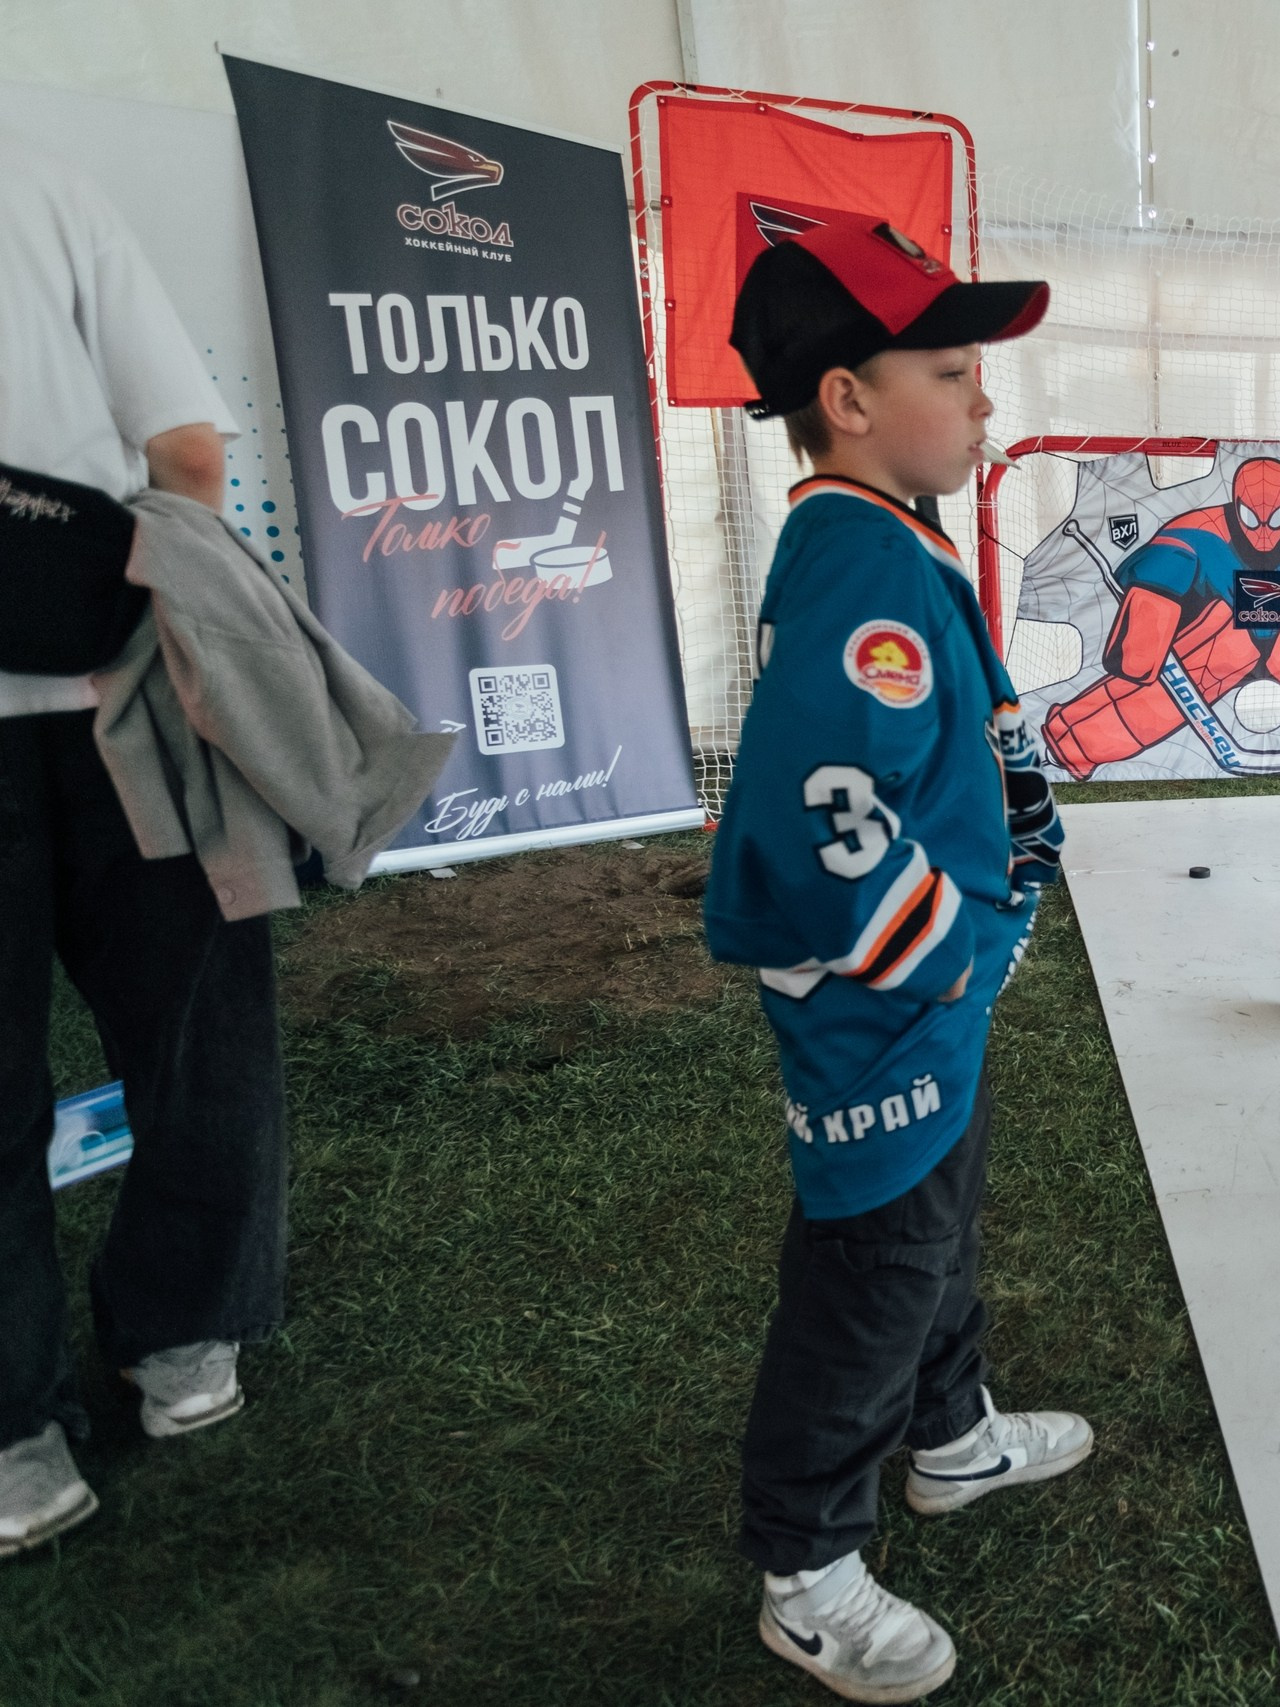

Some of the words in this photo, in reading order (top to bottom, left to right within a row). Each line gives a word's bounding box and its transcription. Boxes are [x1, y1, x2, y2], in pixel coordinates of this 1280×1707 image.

[405, 237, 478, 257] ХОККЕЙНЫЙ
[482, 250, 512, 262] КЛУБ
[329, 293, 589, 374] ТОЛЬКО
[321, 395, 625, 517] СОКОЛ
[341, 493, 491, 563] Только
[1112, 522, 1136, 540] ВХЛ
[431, 530, 608, 642] победа!
[1163, 663, 1241, 771] Hockey
[424, 787, 509, 840] Будь
[515, 787, 530, 806] с
[535, 744, 623, 801] нами!
[804, 766, 901, 880] 3
[822, 1073, 941, 1143] КРАЙ
